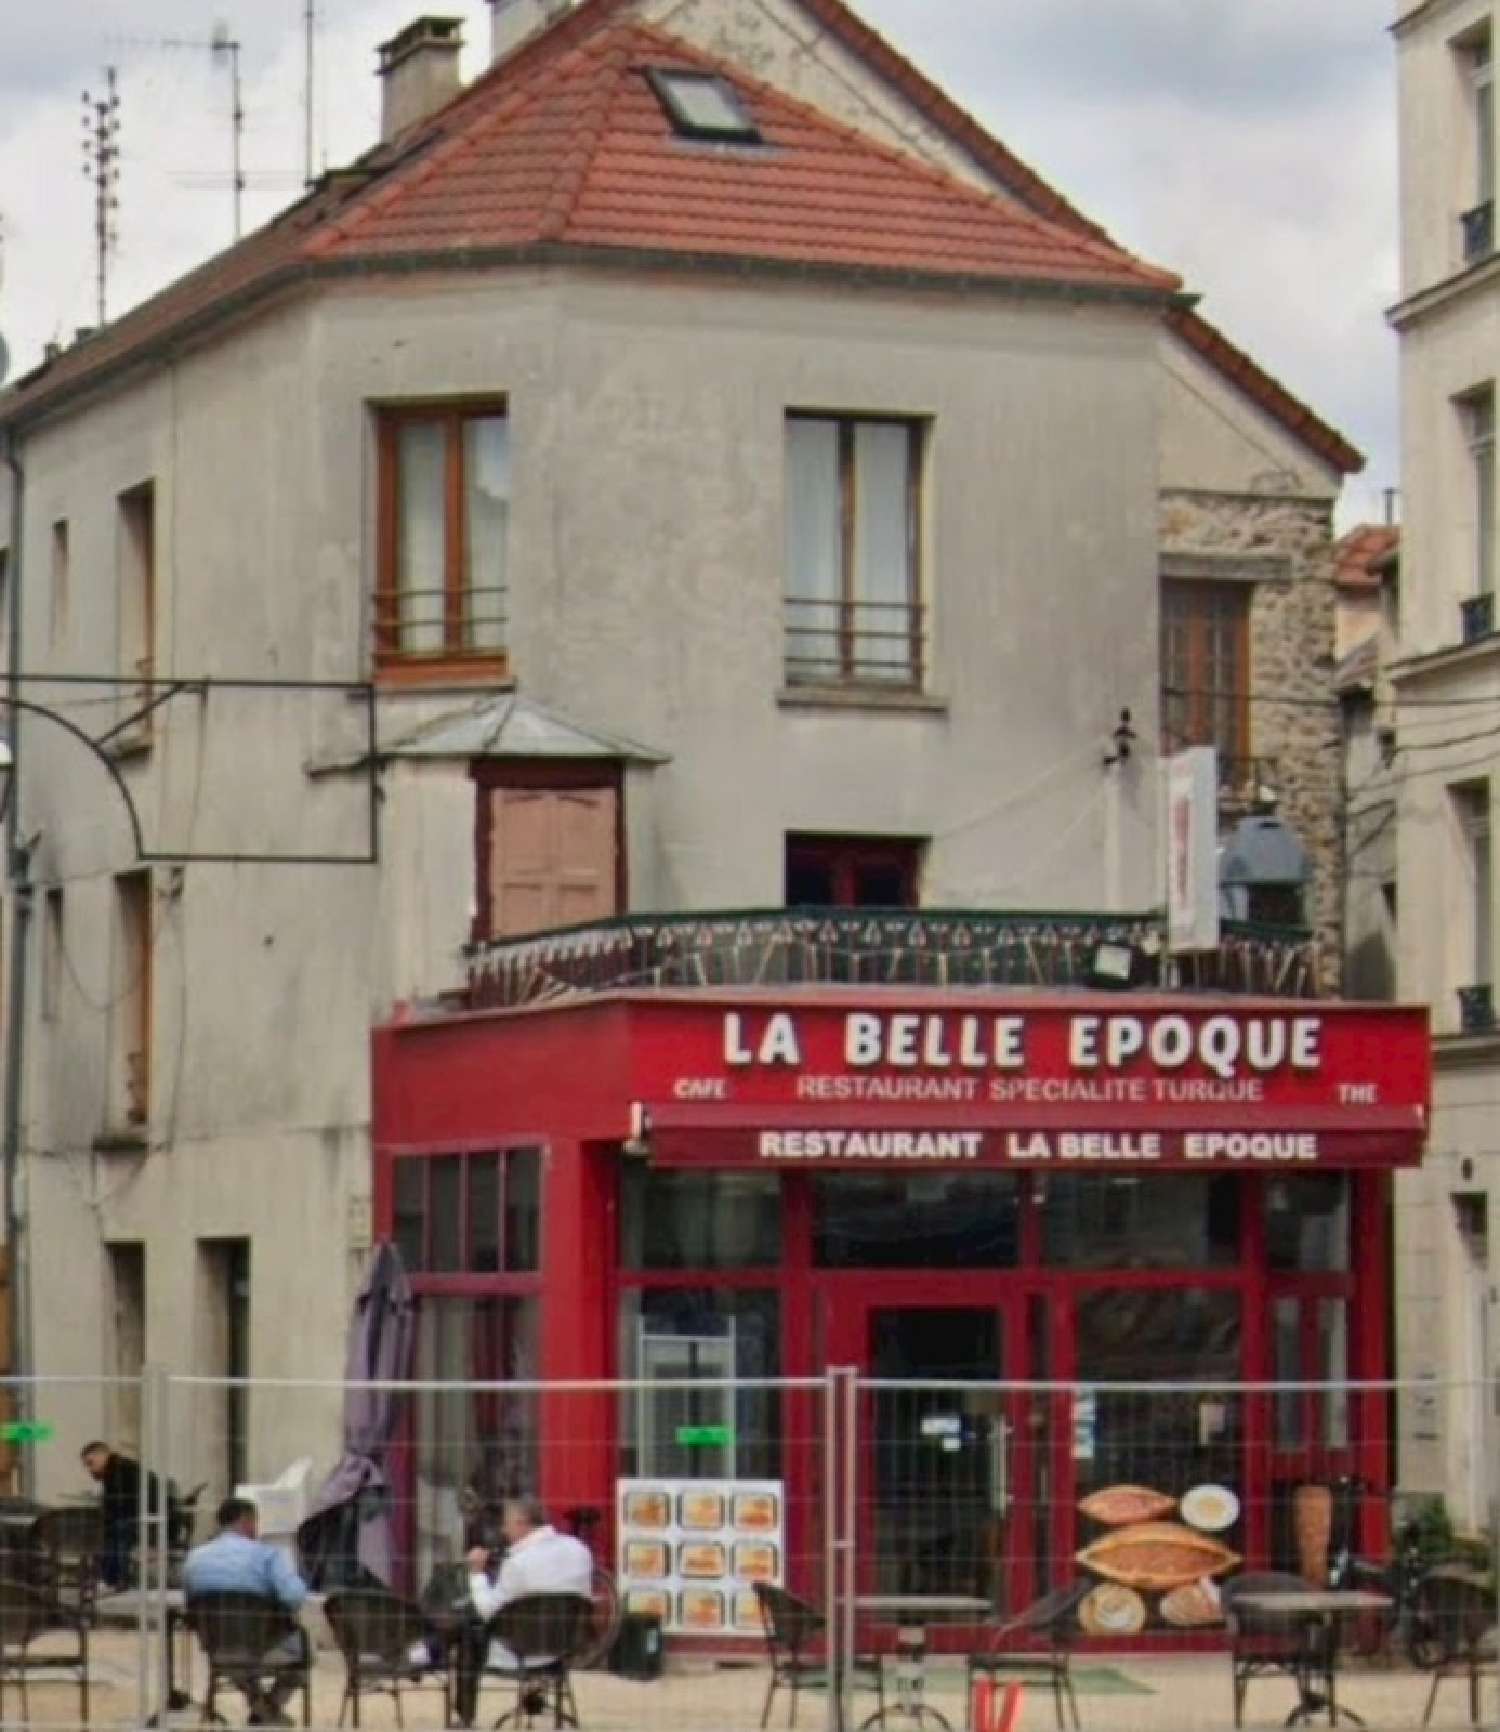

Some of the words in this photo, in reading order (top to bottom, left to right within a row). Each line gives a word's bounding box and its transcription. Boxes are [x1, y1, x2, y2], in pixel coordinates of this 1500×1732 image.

[724, 1012, 799, 1065] LA
[845, 1013, 1025, 1067] BELLE
[1069, 1016, 1322, 1077] EPOQUE
[798, 1077, 978, 1101] RESTAURANT
[990, 1077, 1146, 1101] SPECIALITE
[1154, 1078, 1264, 1102] TURQUE
[760, 1130, 983, 1158] RESTAURANT
[1008, 1132, 1050, 1158] LA
[1058, 1132, 1161, 1159] BELLE
[1184, 1133, 1318, 1160] EPOQUE
